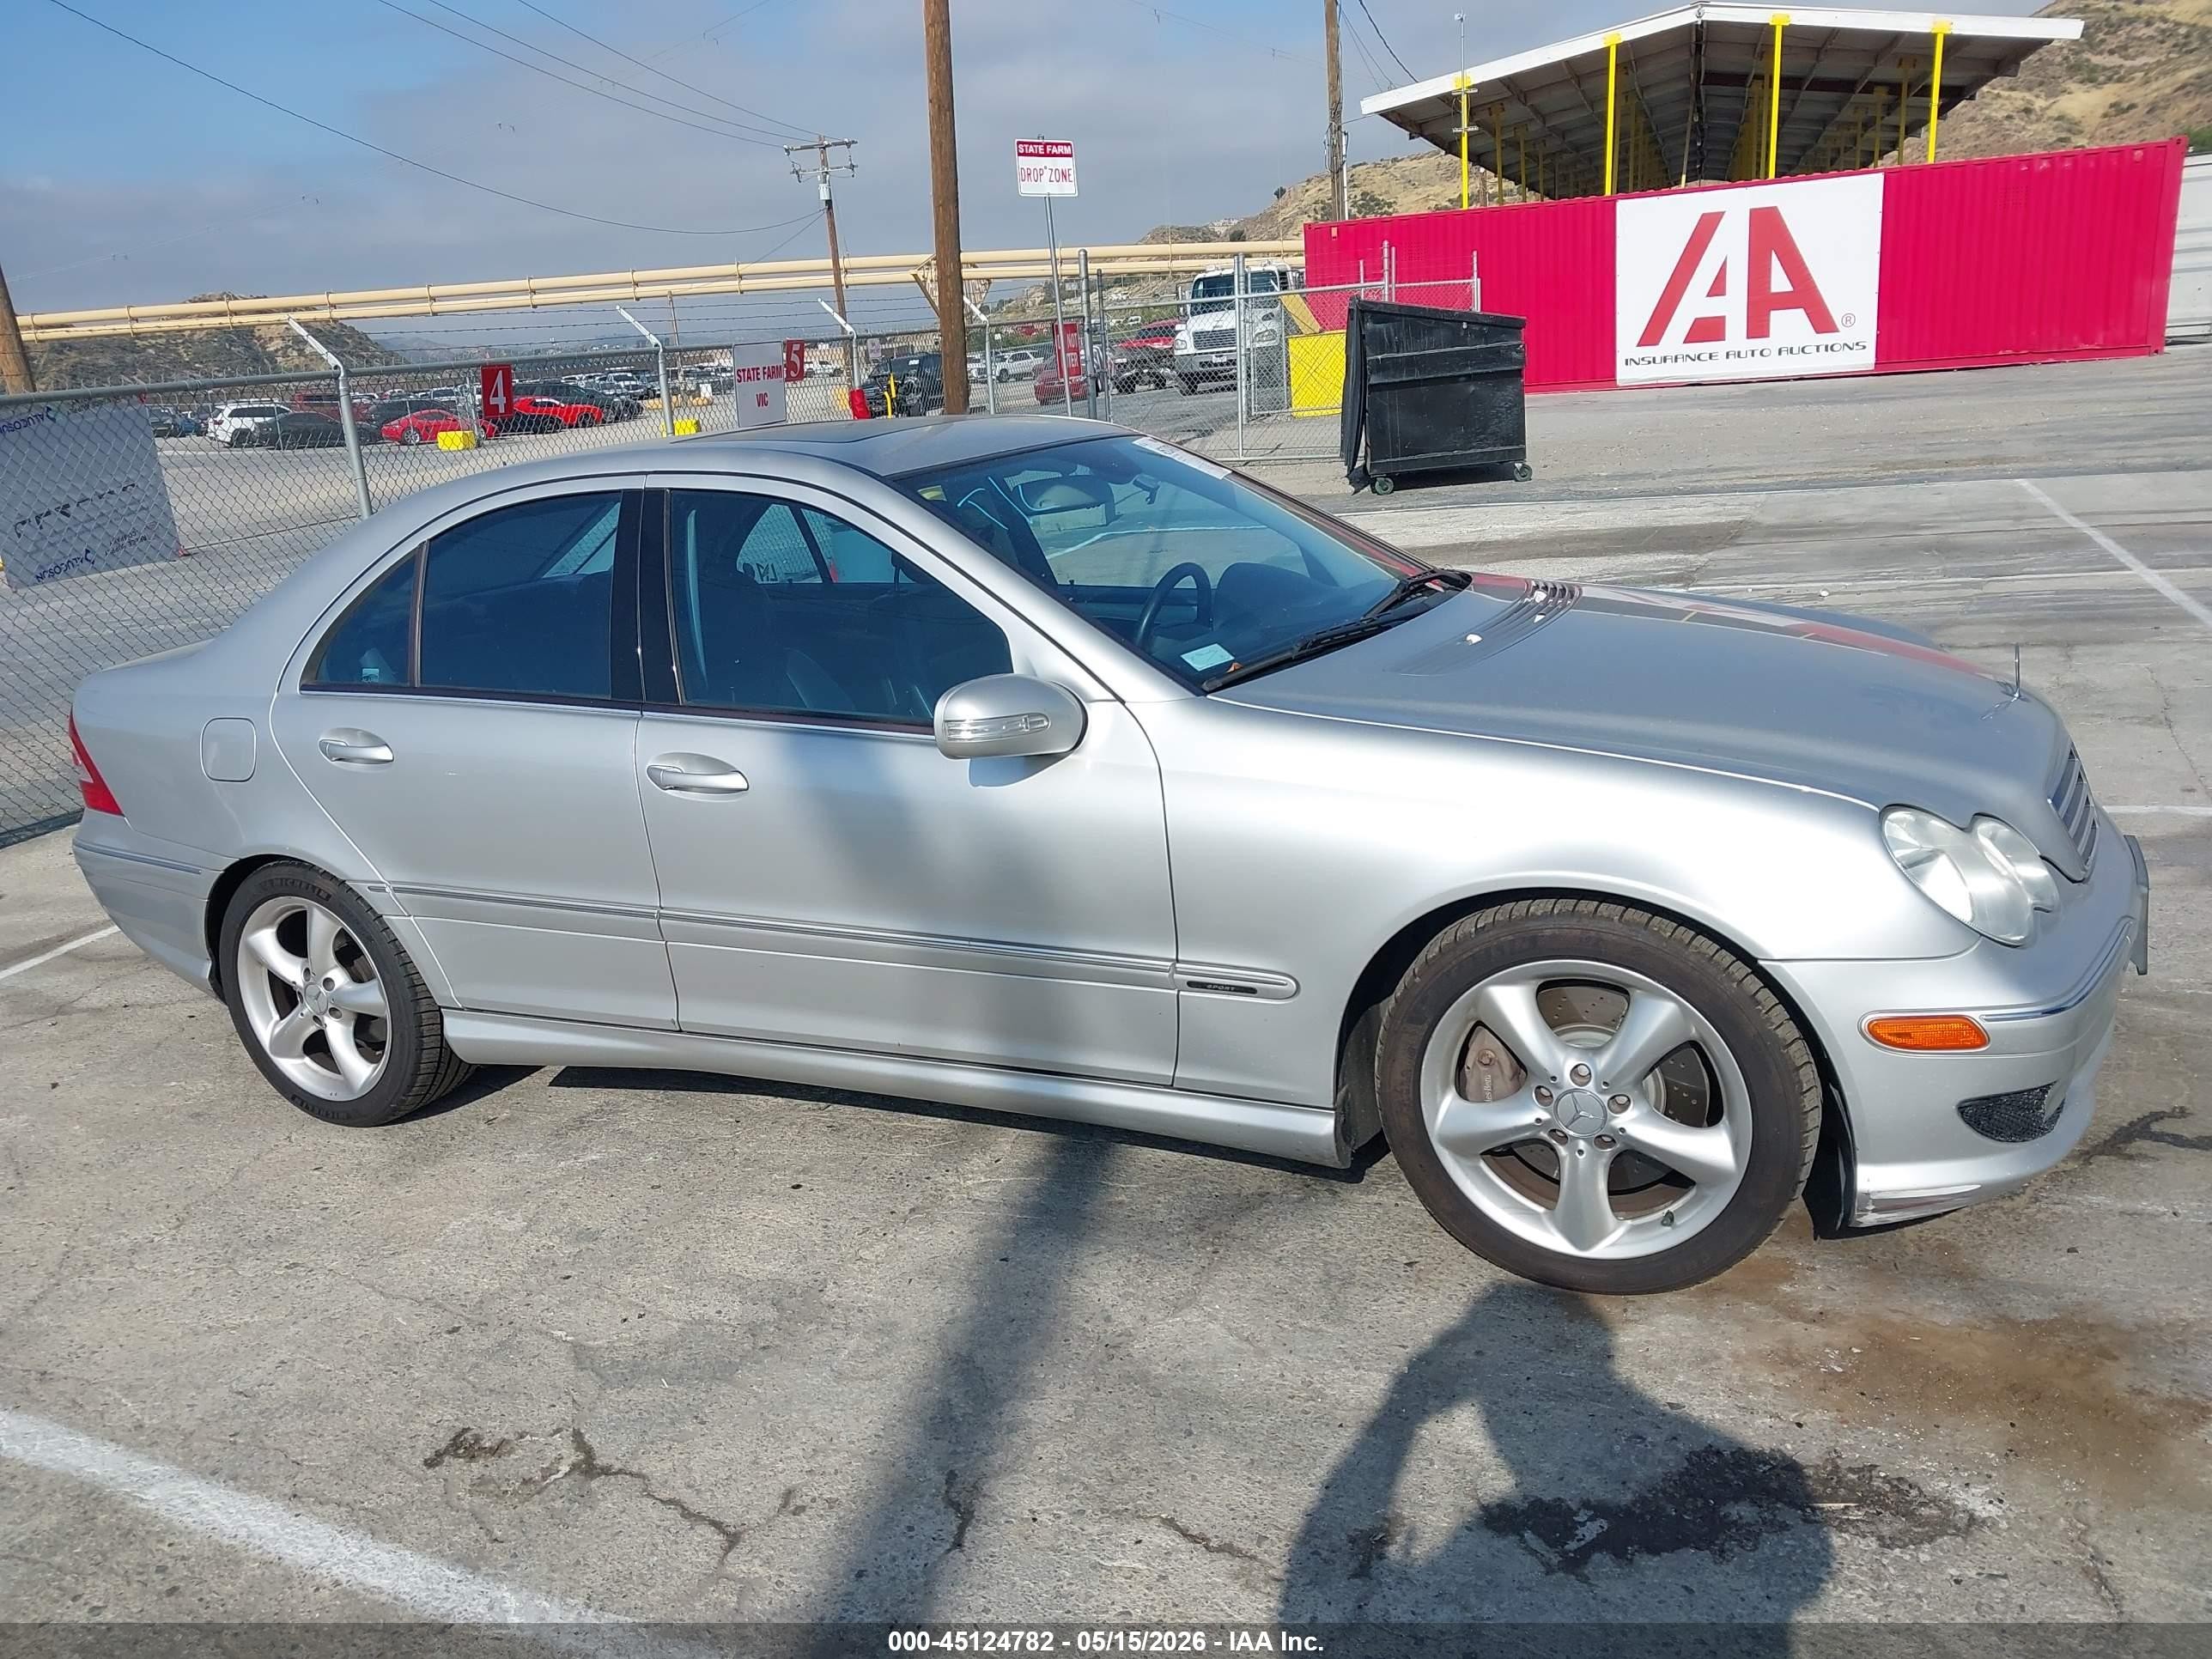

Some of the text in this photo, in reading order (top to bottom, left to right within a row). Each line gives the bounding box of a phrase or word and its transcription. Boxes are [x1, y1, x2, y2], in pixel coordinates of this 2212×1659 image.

[1018, 144, 1072, 155] STATE FARM
[1020, 167, 1073, 183] DROP ZONE
[790, 343, 800, 378] 5
[1625, 341, 1868, 367] INSURANCE AUTO AUCTIONS
[737, 364, 783, 383] STATE FARM
[489, 370, 506, 413] 4
[756, 392, 769, 407] VIC
[0, 412, 46, 434] ALUCOSU
